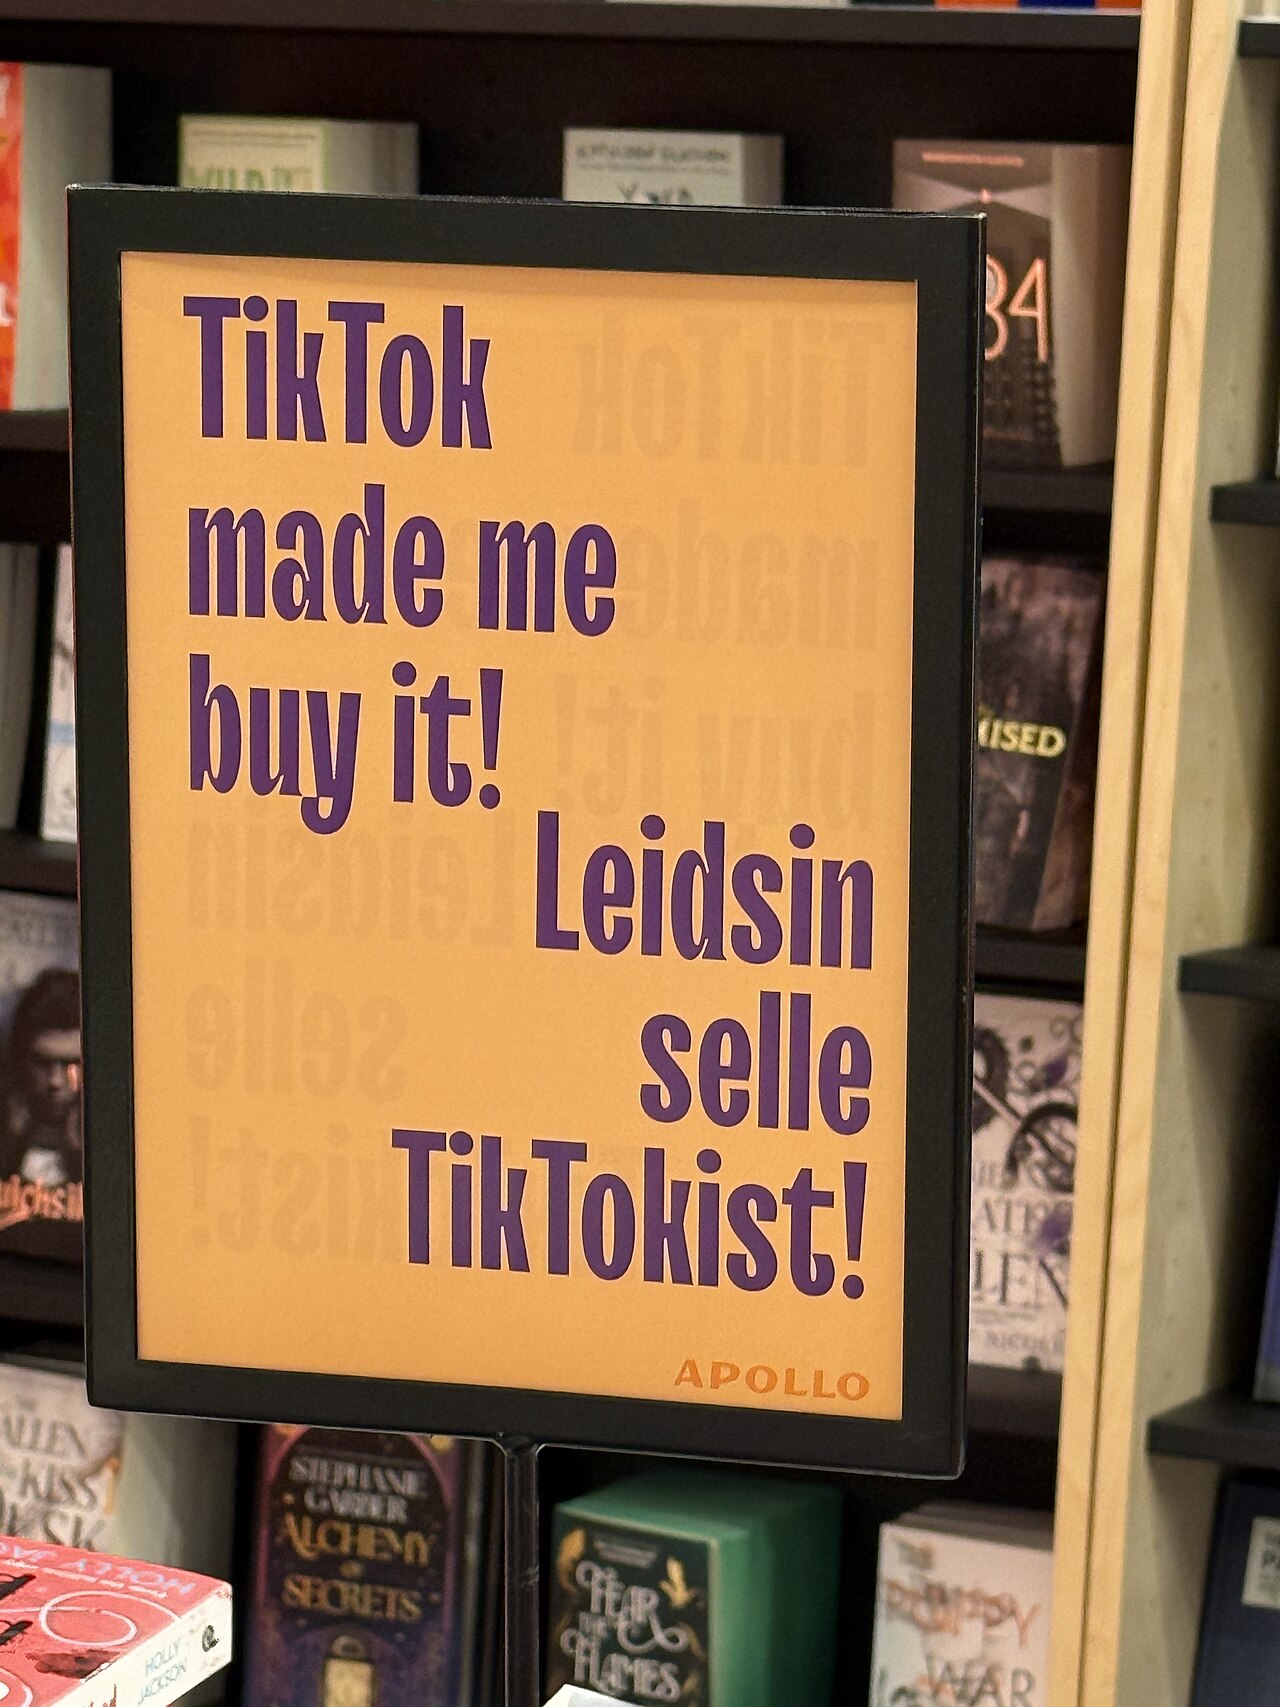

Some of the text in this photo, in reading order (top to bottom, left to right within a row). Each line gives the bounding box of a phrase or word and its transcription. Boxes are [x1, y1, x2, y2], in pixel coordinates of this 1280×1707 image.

[184, 295, 492, 449] TikTok
[190, 485, 445, 627] made
[480, 522, 616, 635] me
[191, 655, 502, 834] buy it!
[536, 811, 873, 969] Leidsin
[641, 991, 873, 1135] selle
[392, 1130, 868, 1300] TikTokist!
[674, 1358, 871, 1401] APOLLO
[283, 1573, 424, 1623] SECRETS
